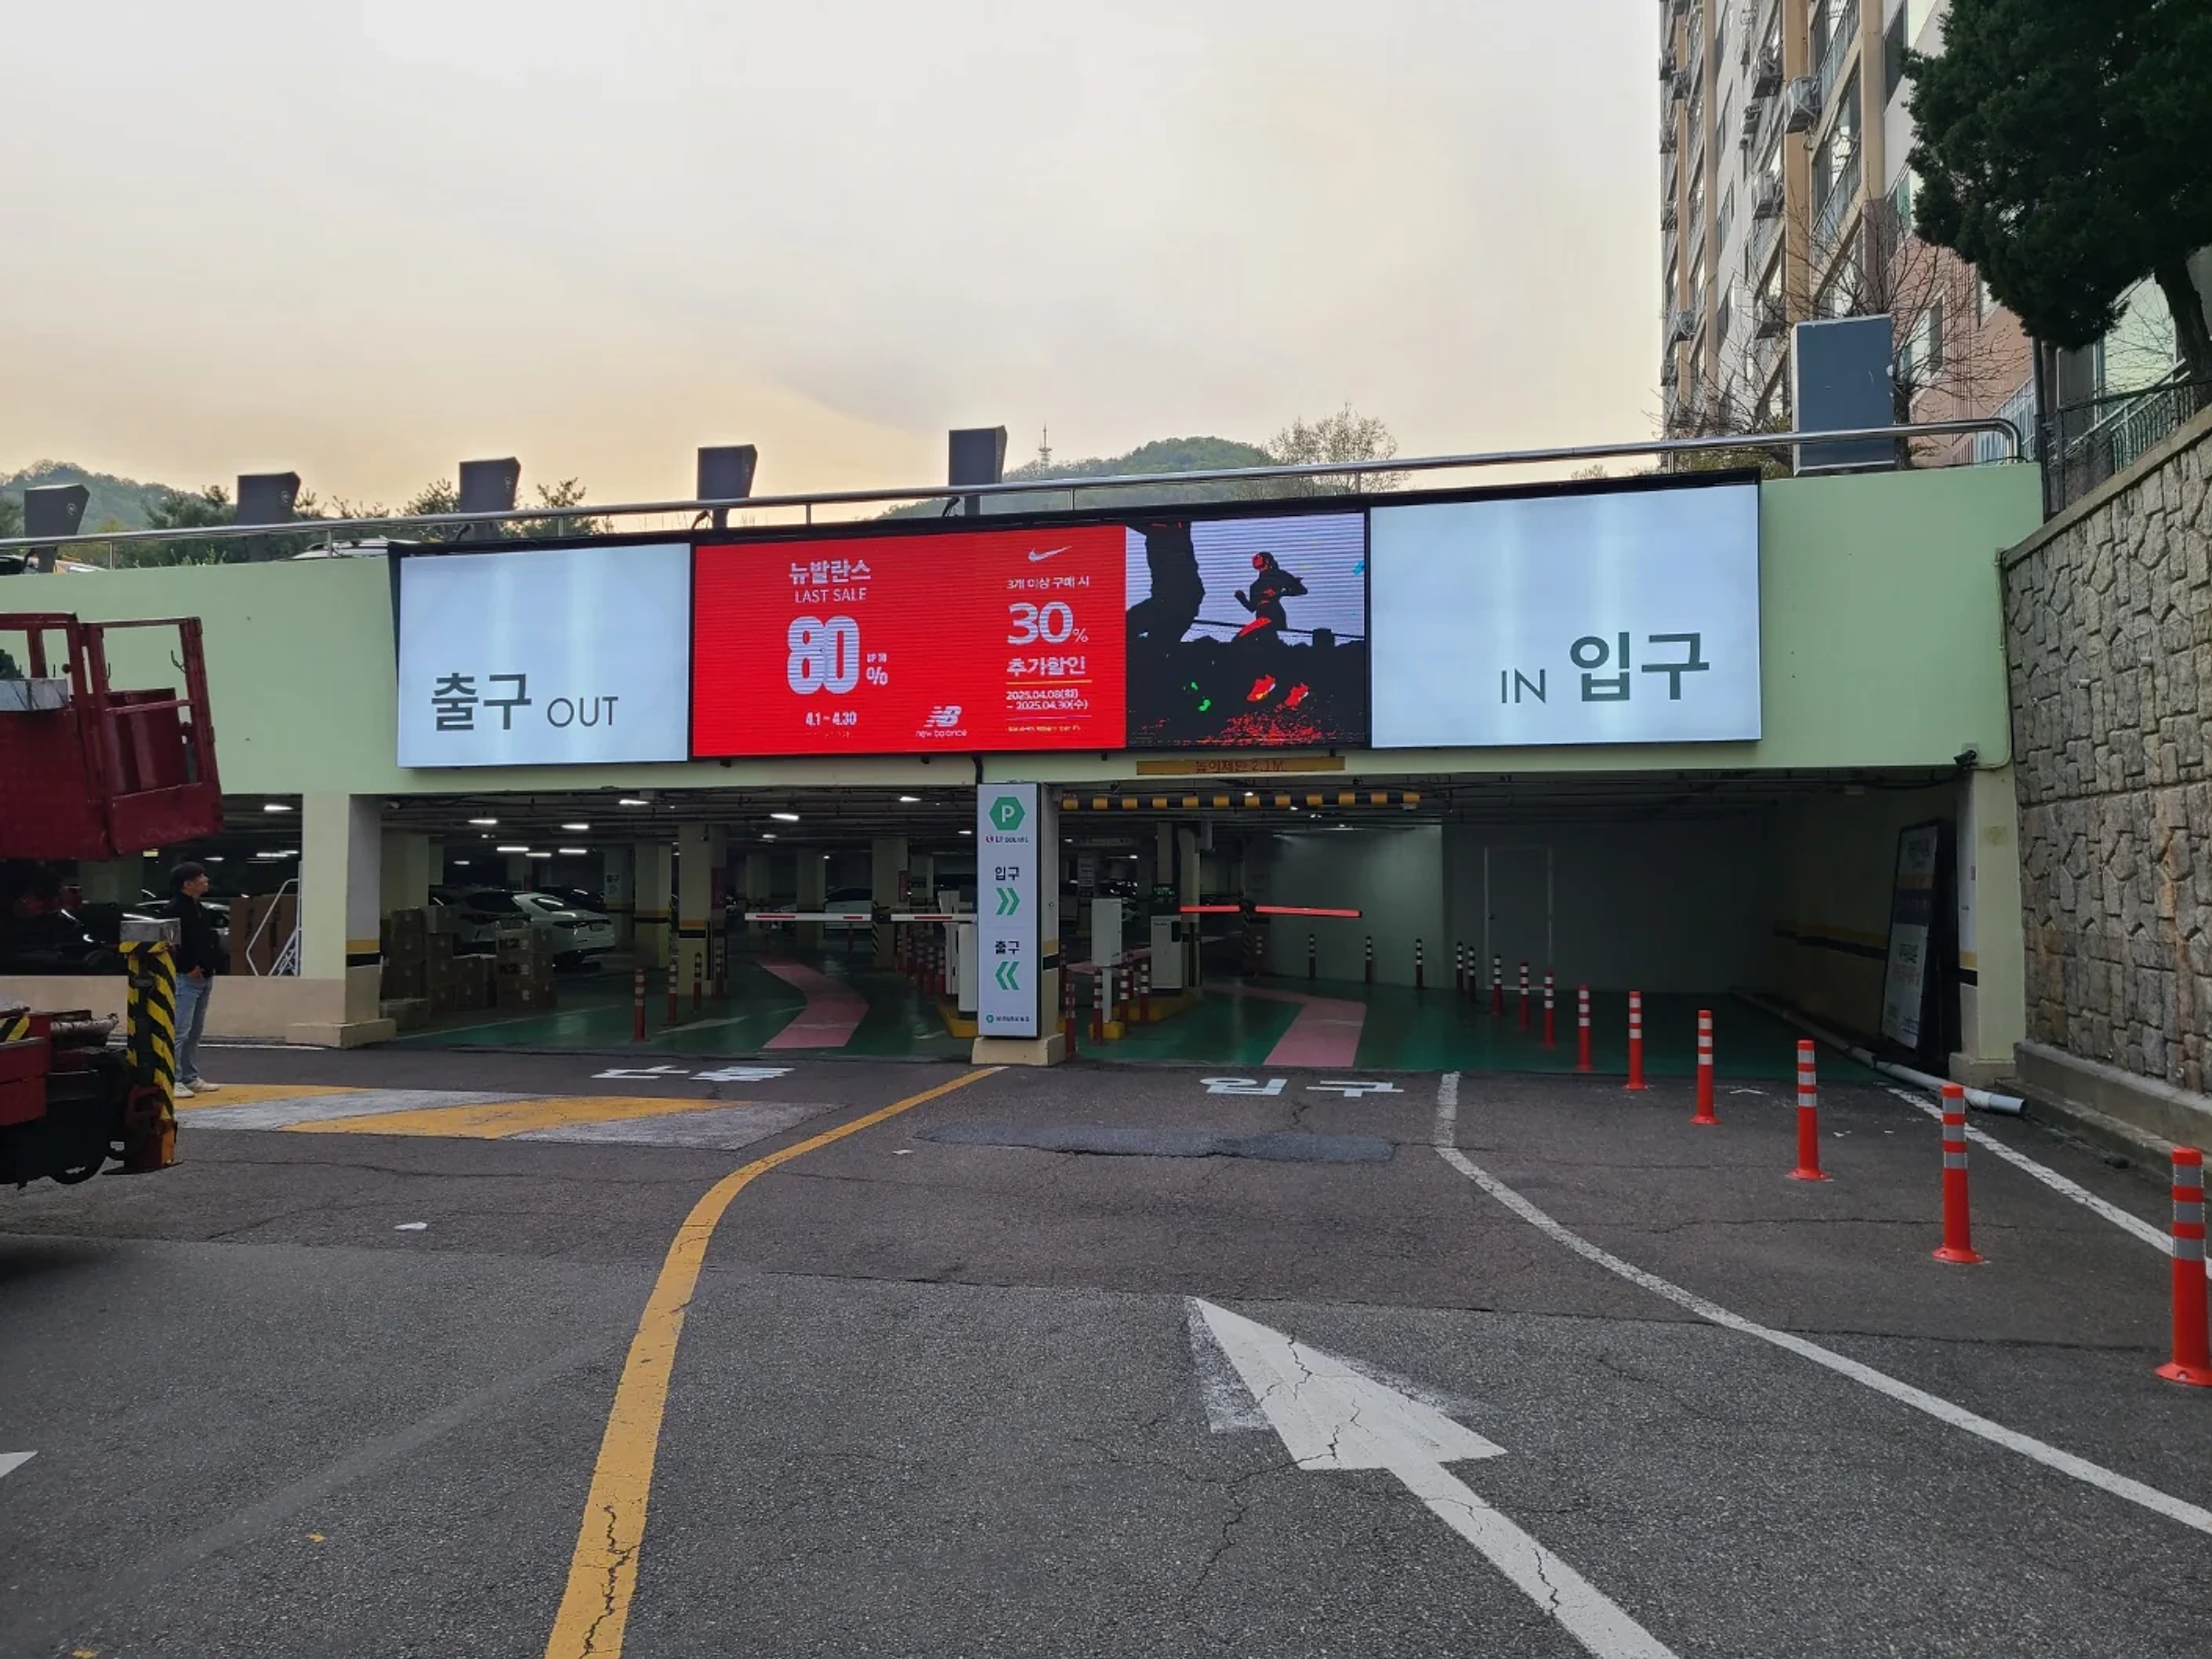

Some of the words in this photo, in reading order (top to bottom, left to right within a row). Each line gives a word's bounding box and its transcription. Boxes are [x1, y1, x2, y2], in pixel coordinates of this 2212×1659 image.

[789, 559, 872, 585] 뉴발란스
[1028, 577, 1050, 590] 이상
[1053, 576, 1075, 589] 구매
[1078, 575, 1090, 587] 시
[795, 589, 829, 603] LAST
[833, 587, 867, 602] SALE
[1006, 655, 1086, 677] 추가할인
[1502, 668, 1546, 704] IN
[1569, 631, 1710, 702] 입구
[431, 673, 532, 731] 출구
[547, 696, 618, 728] OUT
[995, 866, 1020, 880] 입구
[995, 941, 1020, 955] 출구
[1199, 1077, 1405, 1098] 입구
